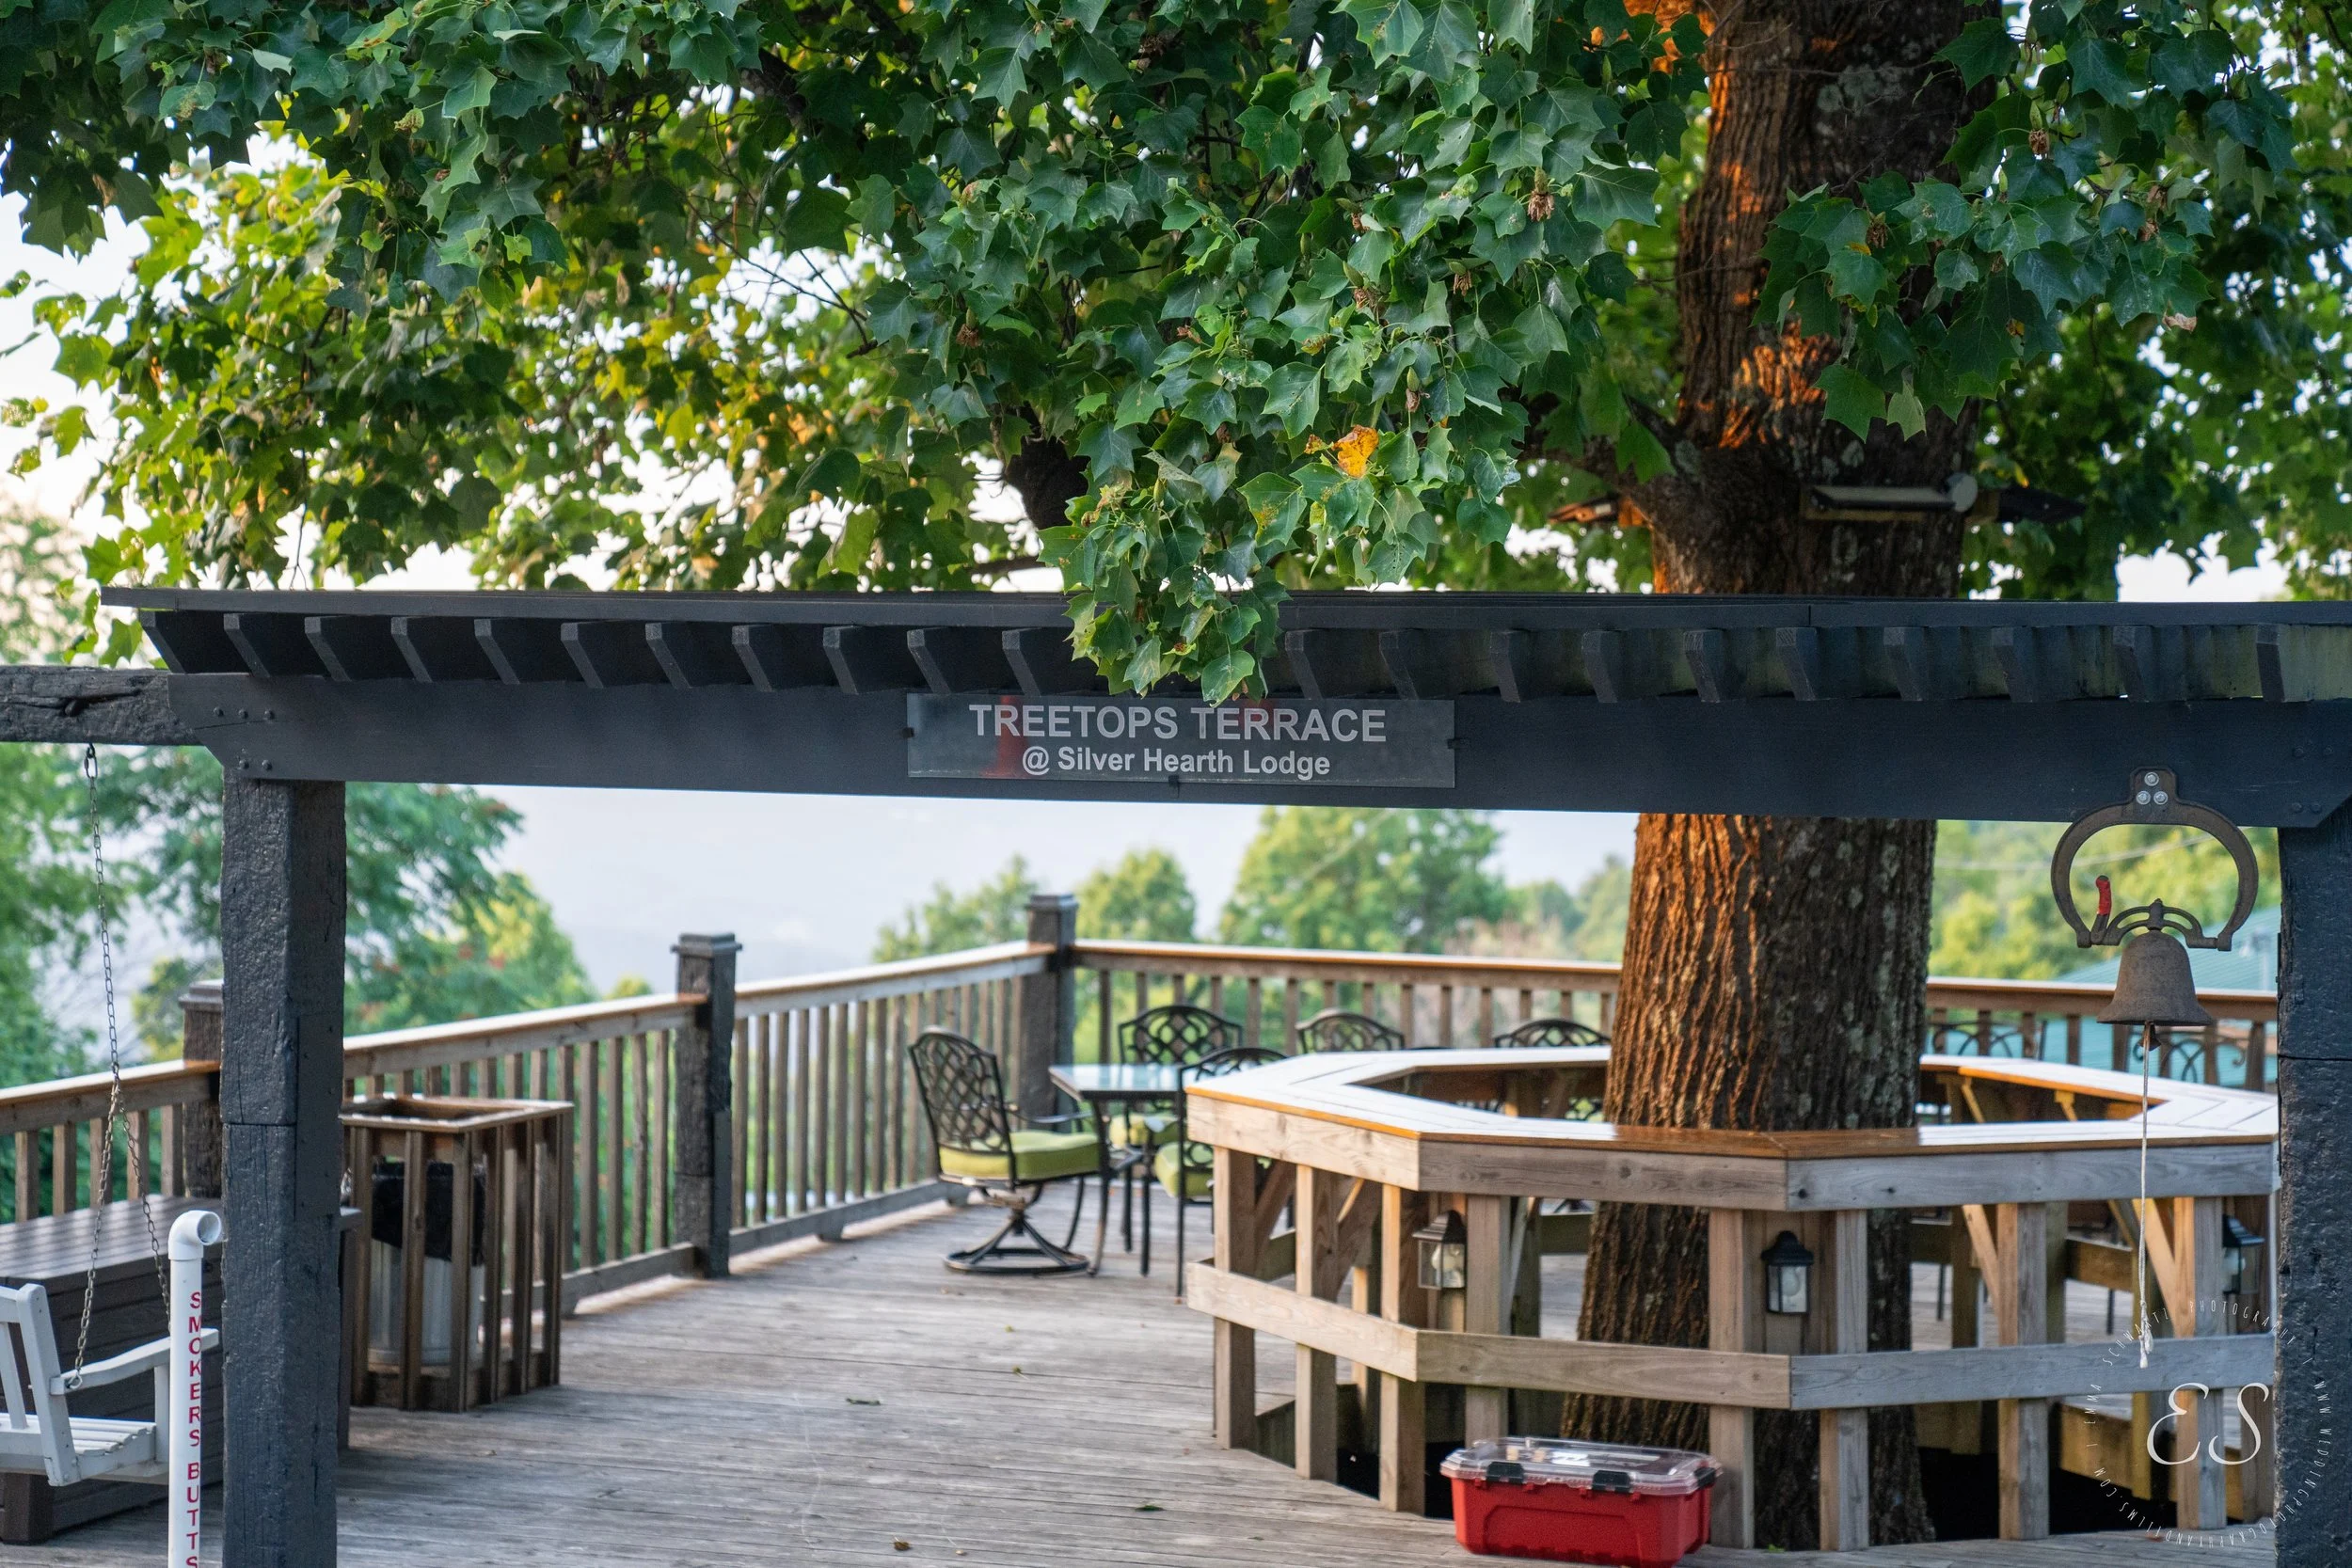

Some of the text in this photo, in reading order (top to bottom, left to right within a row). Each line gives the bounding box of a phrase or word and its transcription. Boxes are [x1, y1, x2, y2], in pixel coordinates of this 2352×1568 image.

[969, 705, 1387, 742] TREETOPS TERRACE
[1022, 746, 1330, 780] @ Silver Hearth Lodge
[186, 1291, 201, 1568] SMOKERS BUTTS
